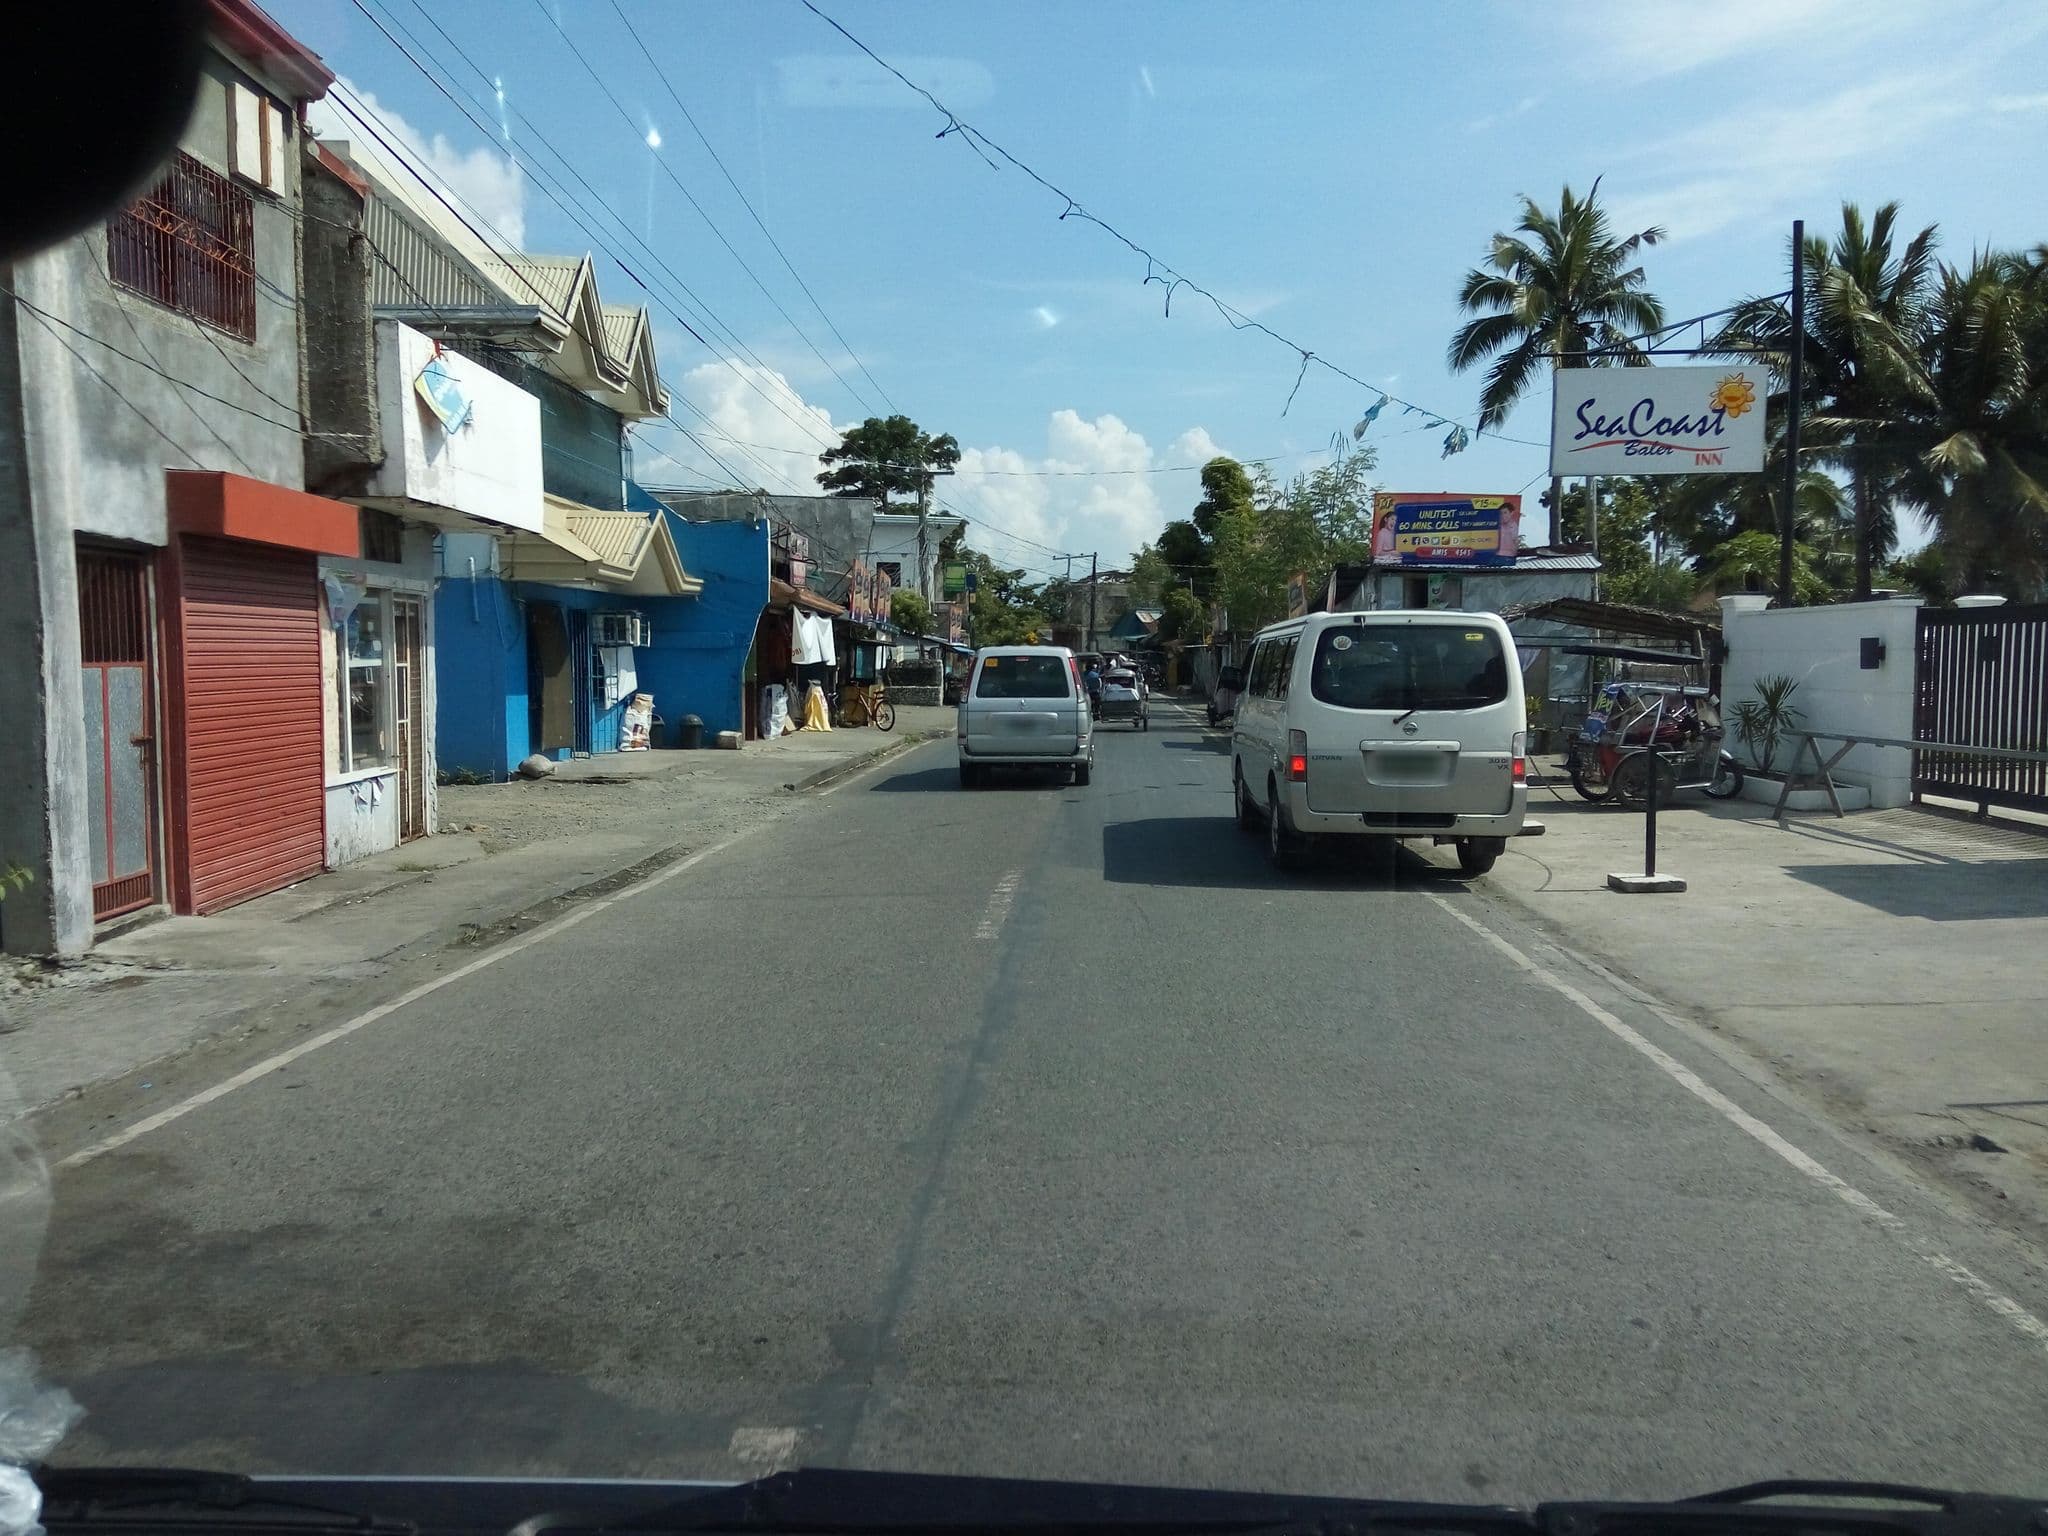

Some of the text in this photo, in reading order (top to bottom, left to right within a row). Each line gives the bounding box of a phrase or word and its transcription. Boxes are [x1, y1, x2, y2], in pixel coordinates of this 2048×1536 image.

[1624, 439, 1674, 456] Baler
[1695, 453, 1723, 466] INN
[1399, 522, 1410, 531] 60
[1435, 520, 1460, 530] CALLS
